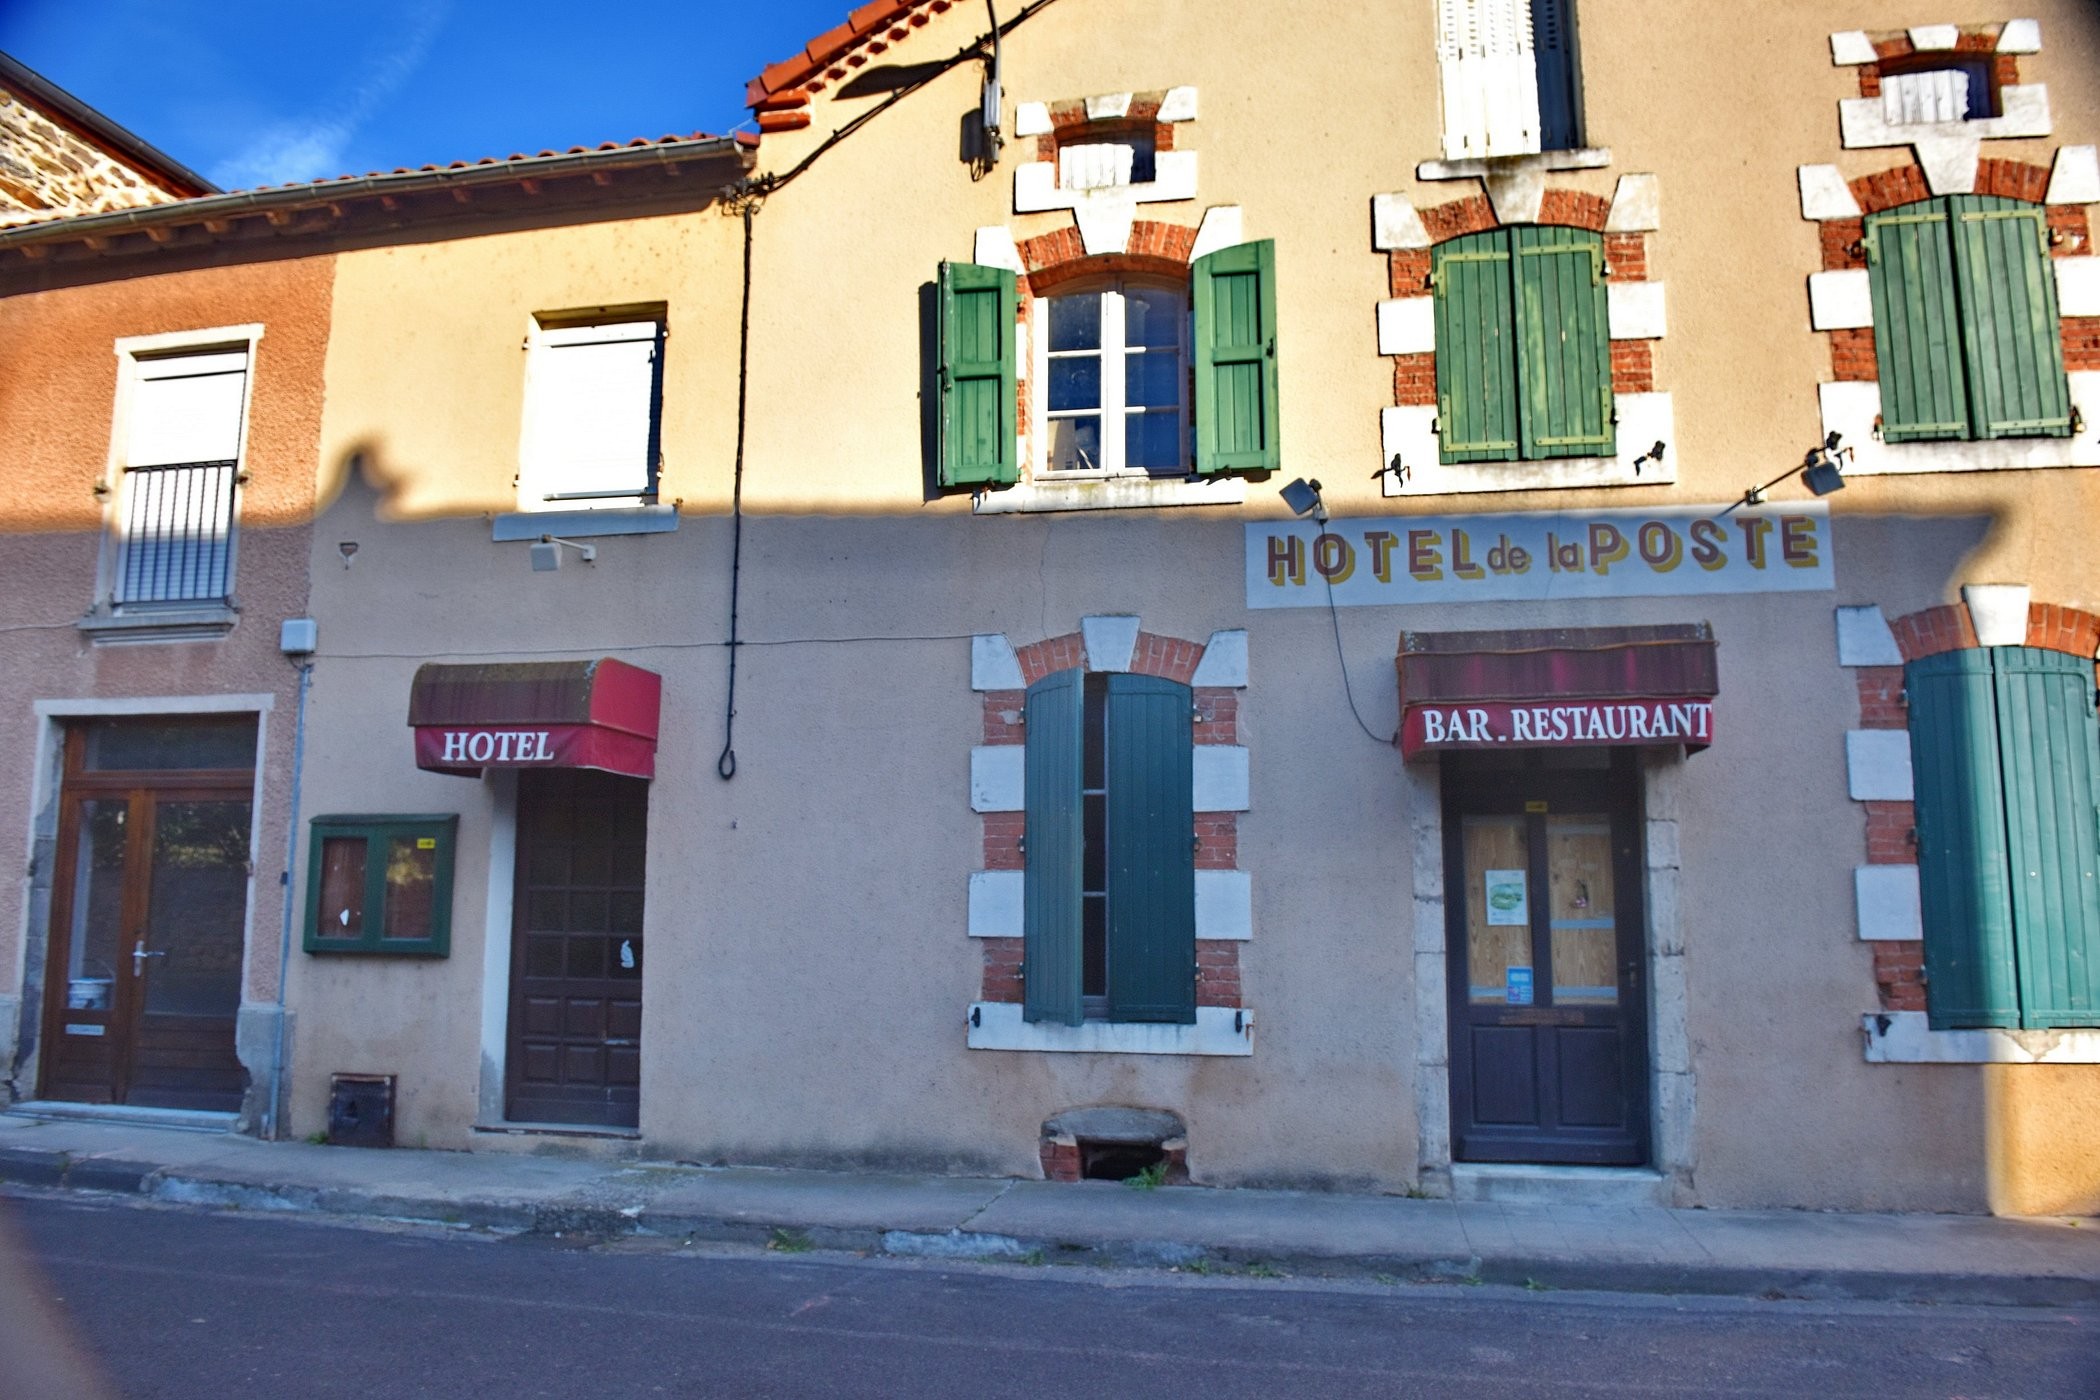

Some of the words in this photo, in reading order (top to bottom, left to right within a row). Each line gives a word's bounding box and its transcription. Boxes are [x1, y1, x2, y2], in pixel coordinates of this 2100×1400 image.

[1267, 528, 1486, 587] HOTEL
[1487, 533, 1532, 575] de
[1547, 531, 1585, 573] la
[1588, 514, 1819, 576] POSTE
[441, 731, 554, 761] HOTEL
